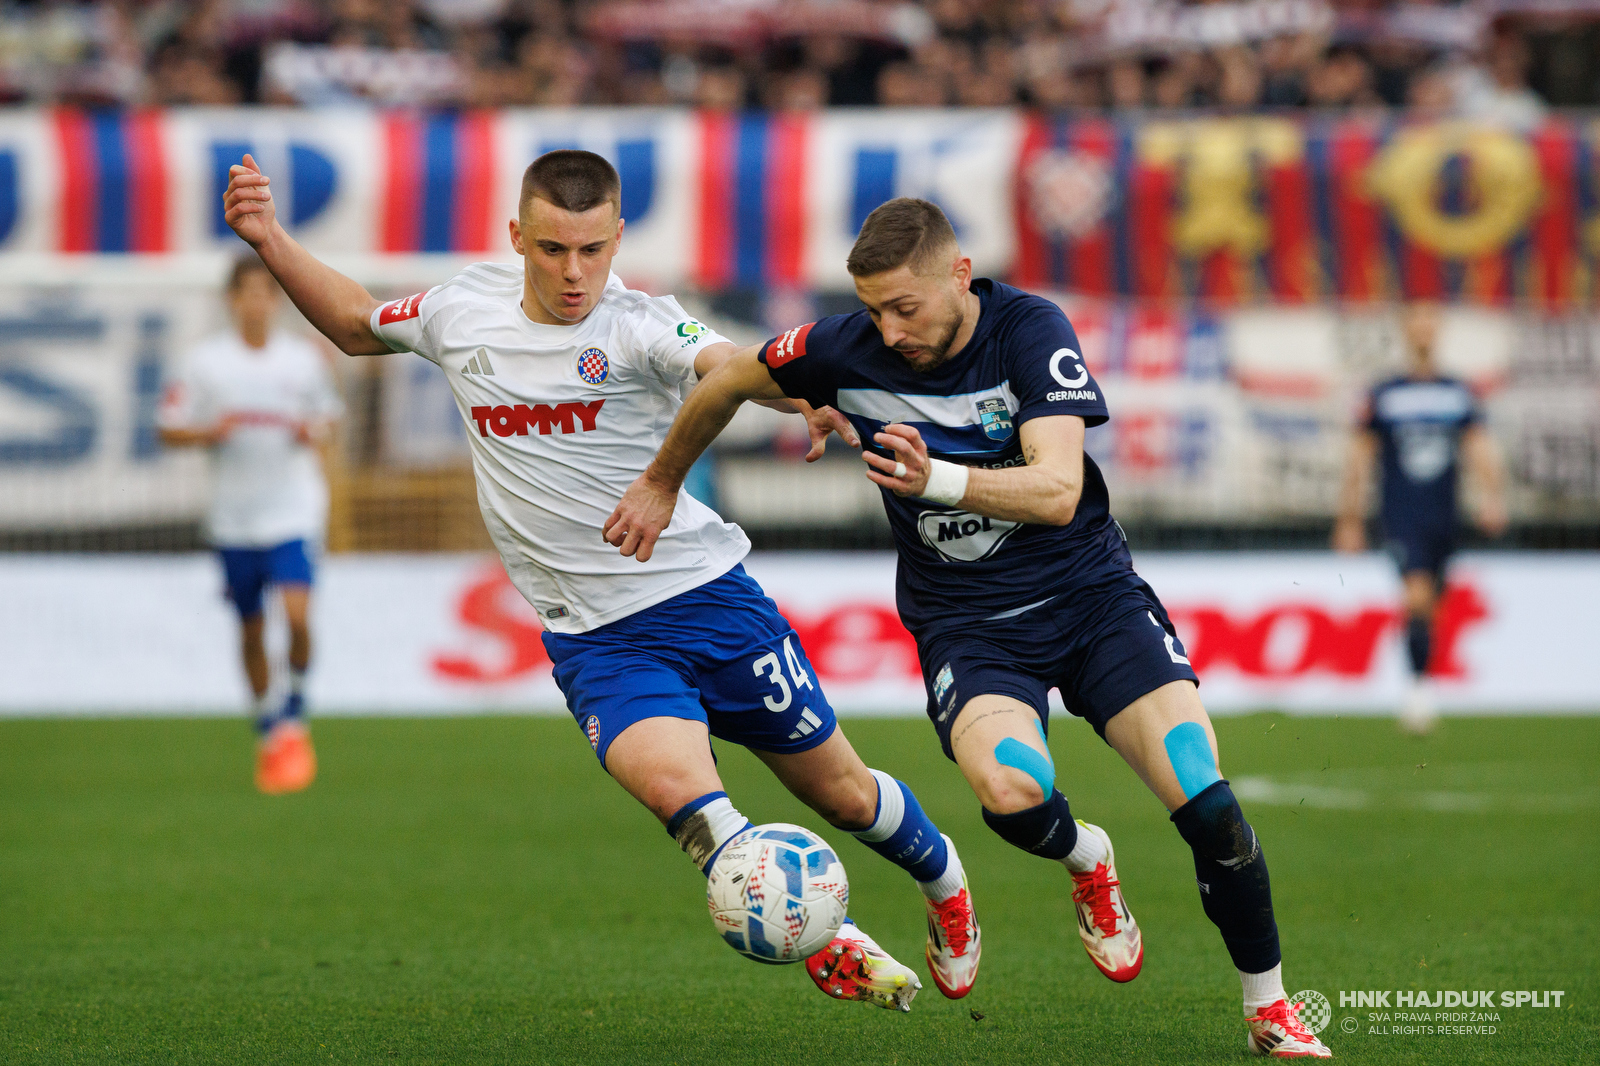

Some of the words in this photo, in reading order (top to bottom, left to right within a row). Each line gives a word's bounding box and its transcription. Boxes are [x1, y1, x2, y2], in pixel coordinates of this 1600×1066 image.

[582, 349, 607, 363] HAJDUK
[582, 373, 602, 384] SPLIT
[1046, 390, 1097, 402] GERMANIA
[471, 398, 606, 438] TOMMY
[937, 516, 994, 543] MOL
[752, 635, 814, 713] 34
[894, 829, 923, 859] 1911
